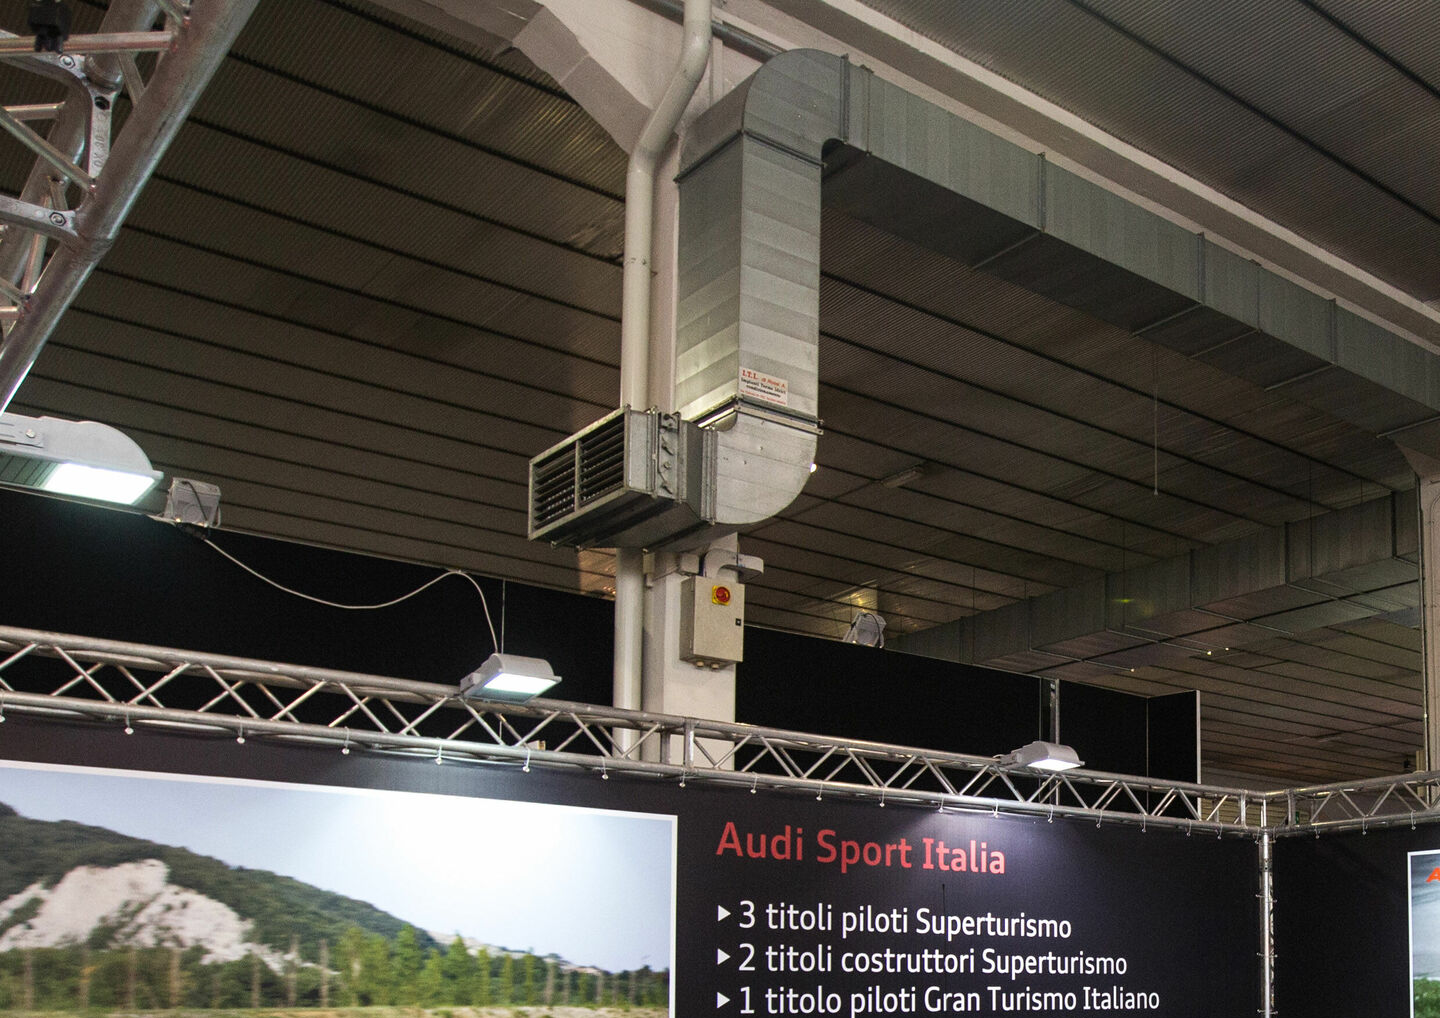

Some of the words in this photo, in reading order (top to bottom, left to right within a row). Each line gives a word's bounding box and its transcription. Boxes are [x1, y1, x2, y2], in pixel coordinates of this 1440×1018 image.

[716, 820, 804, 861] Audi
[816, 828, 912, 874] Sport
[922, 837, 1007, 875] Italia
[738, 901, 756, 930] 3
[766, 901, 833, 931] titoli
[841, 905, 909, 940] piloti
[916, 906, 1072, 939] Superturismo
[738, 943, 756, 972] 2
[766, 944, 833, 973] titoli
[841, 947, 975, 973] costruttori
[982, 948, 1128, 980] Superturismo
[739, 986, 755, 1014] 1
[766, 986, 842, 1014] titolo
[923, 985, 981, 1013] Gran
[986, 984, 1078, 1012] Turismo
[1082, 985, 1161, 1011] Italiano
